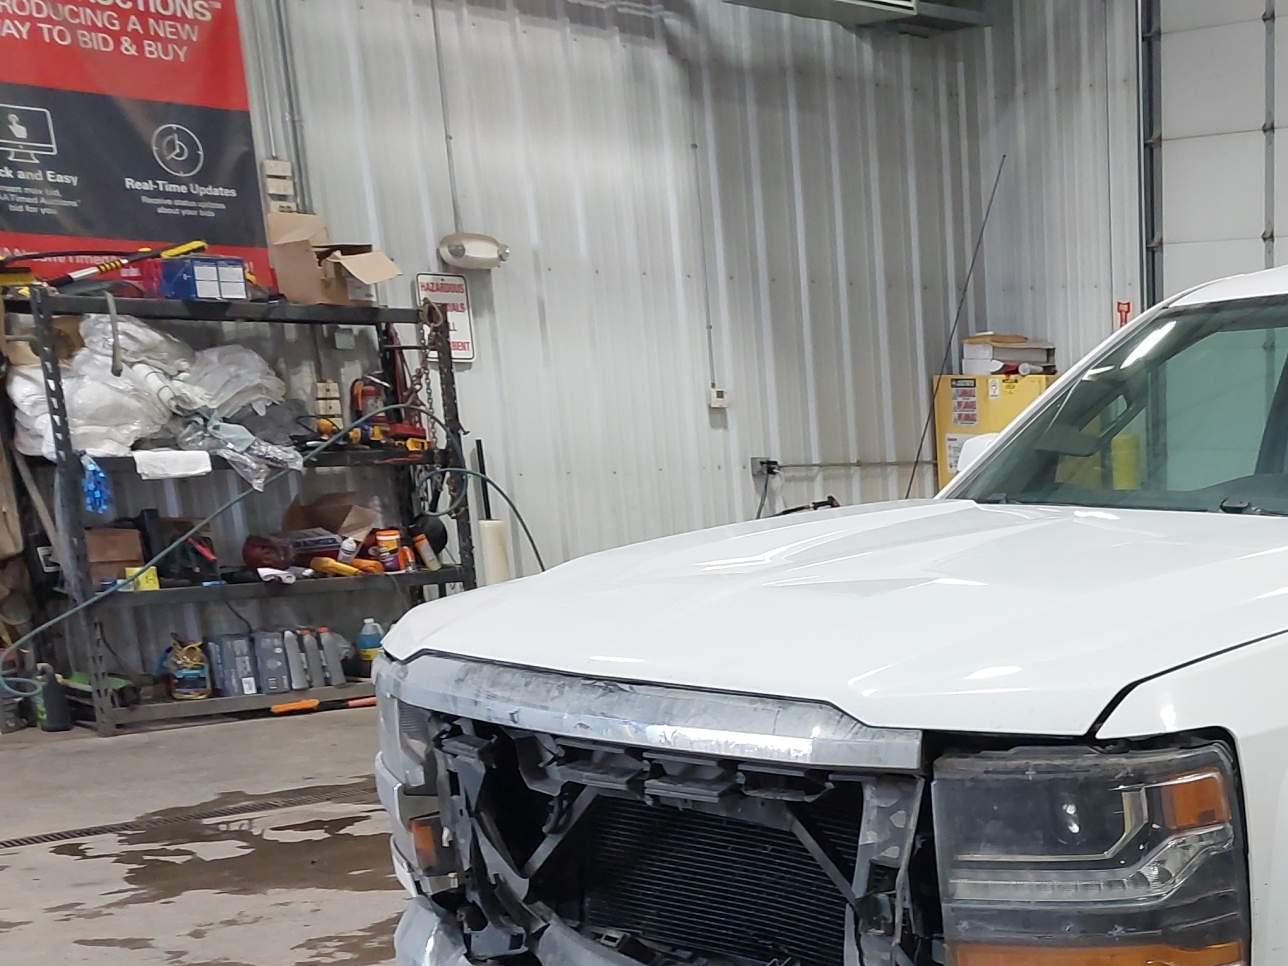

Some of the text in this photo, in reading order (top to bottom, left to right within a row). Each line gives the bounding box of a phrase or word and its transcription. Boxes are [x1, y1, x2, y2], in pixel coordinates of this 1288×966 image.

[127, 15, 144, 34] A
[149, 18, 198, 42] NEW
[37, 23, 72, 46] TO
[77, 30, 114, 51] BID
[120, 37, 138, 56] &
[143, 40, 188, 62] BUY
[17, 169, 43, 181] and
[46, 170, 79, 186] Easy
[124, 177, 238, 198] Real-Time Updates
